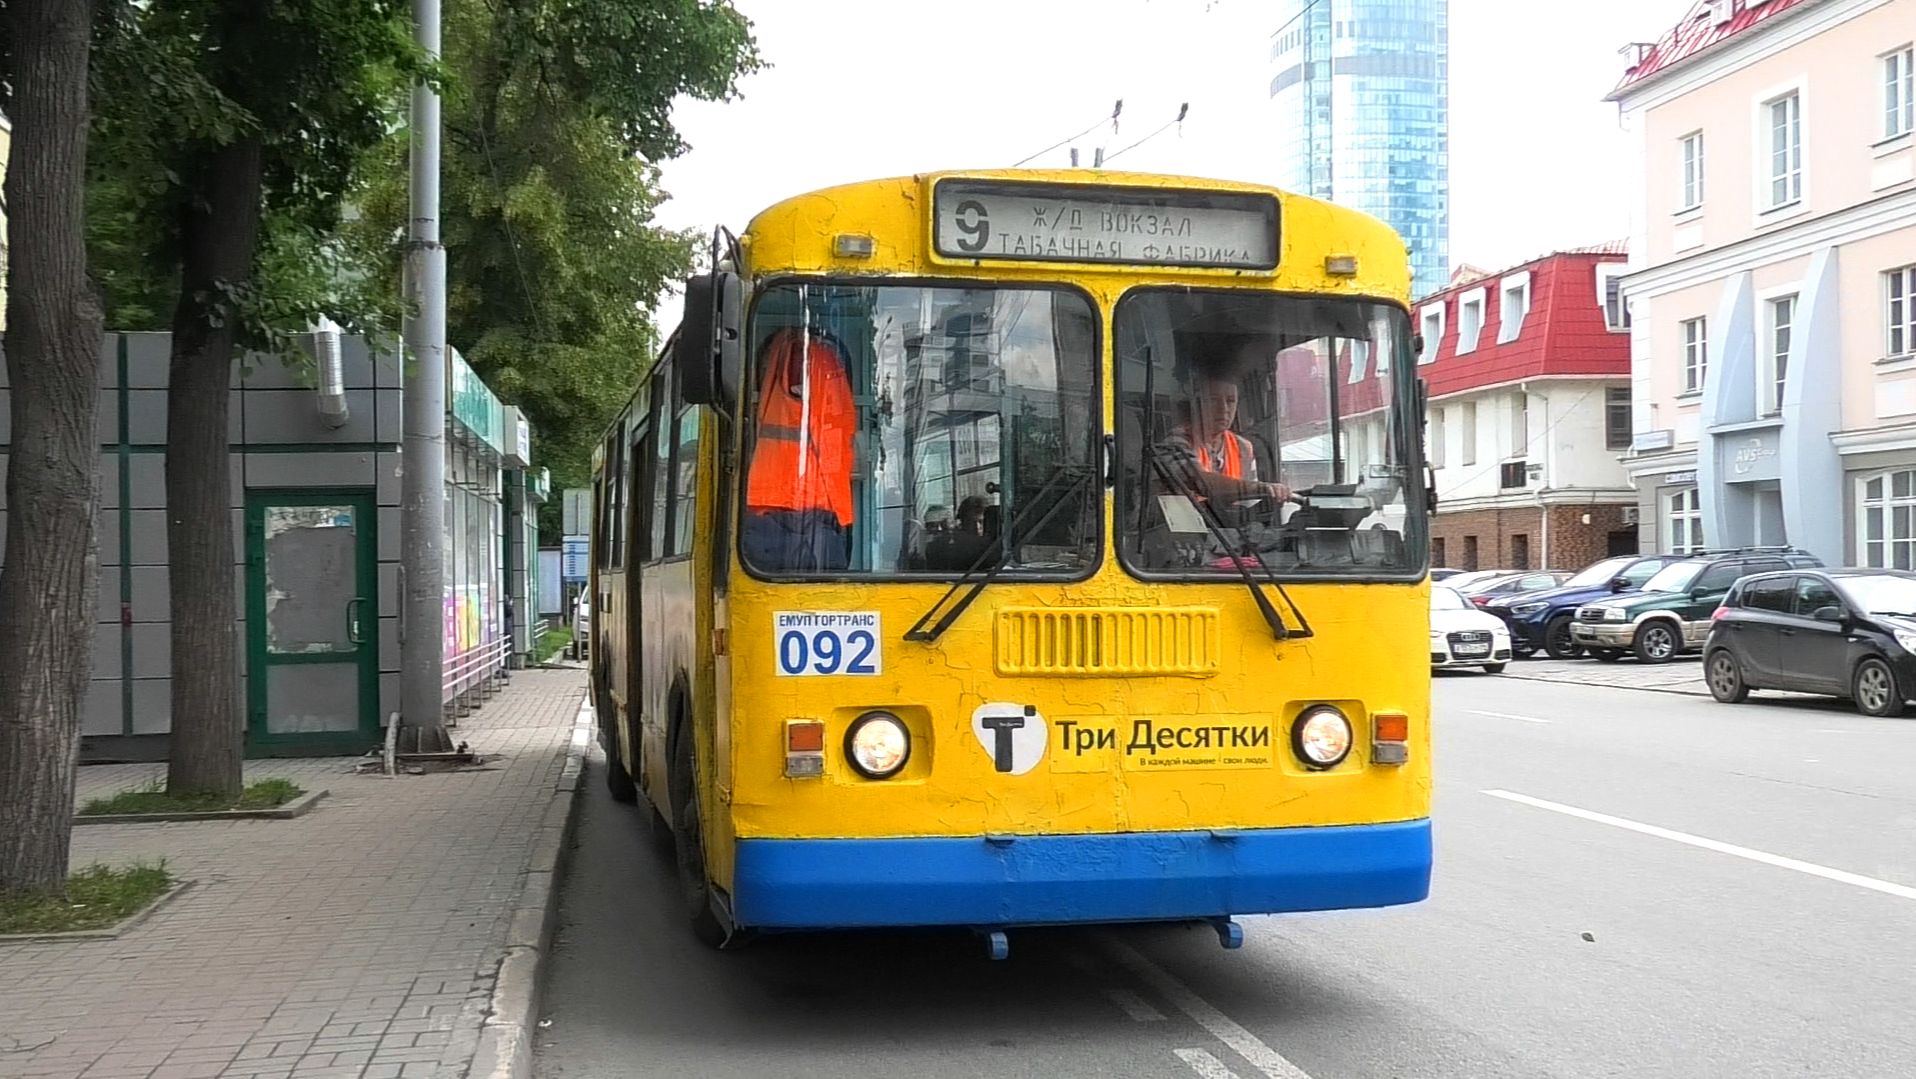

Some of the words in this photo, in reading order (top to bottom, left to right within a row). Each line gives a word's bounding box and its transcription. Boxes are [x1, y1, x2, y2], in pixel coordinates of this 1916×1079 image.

[956, 200, 990, 252] 9
[1033, 206, 1083, 231] Ж/Д
[1101, 210, 1191, 237] ВОКЗАЛ
[998, 233, 1122, 259] ТАБАЧНАЯ
[1142, 243, 1250, 263] ФАБРИКА
[779, 615, 811, 626] ЕМУП
[814, 614, 875, 626] ГОРТРАНС
[780, 630, 875, 675] 092
[1055, 720, 1115, 755] Три
[1126, 719, 1269, 755] Десятки
[1139, 758, 1146, 766] В
[1148, 757, 1181, 766] каждой
